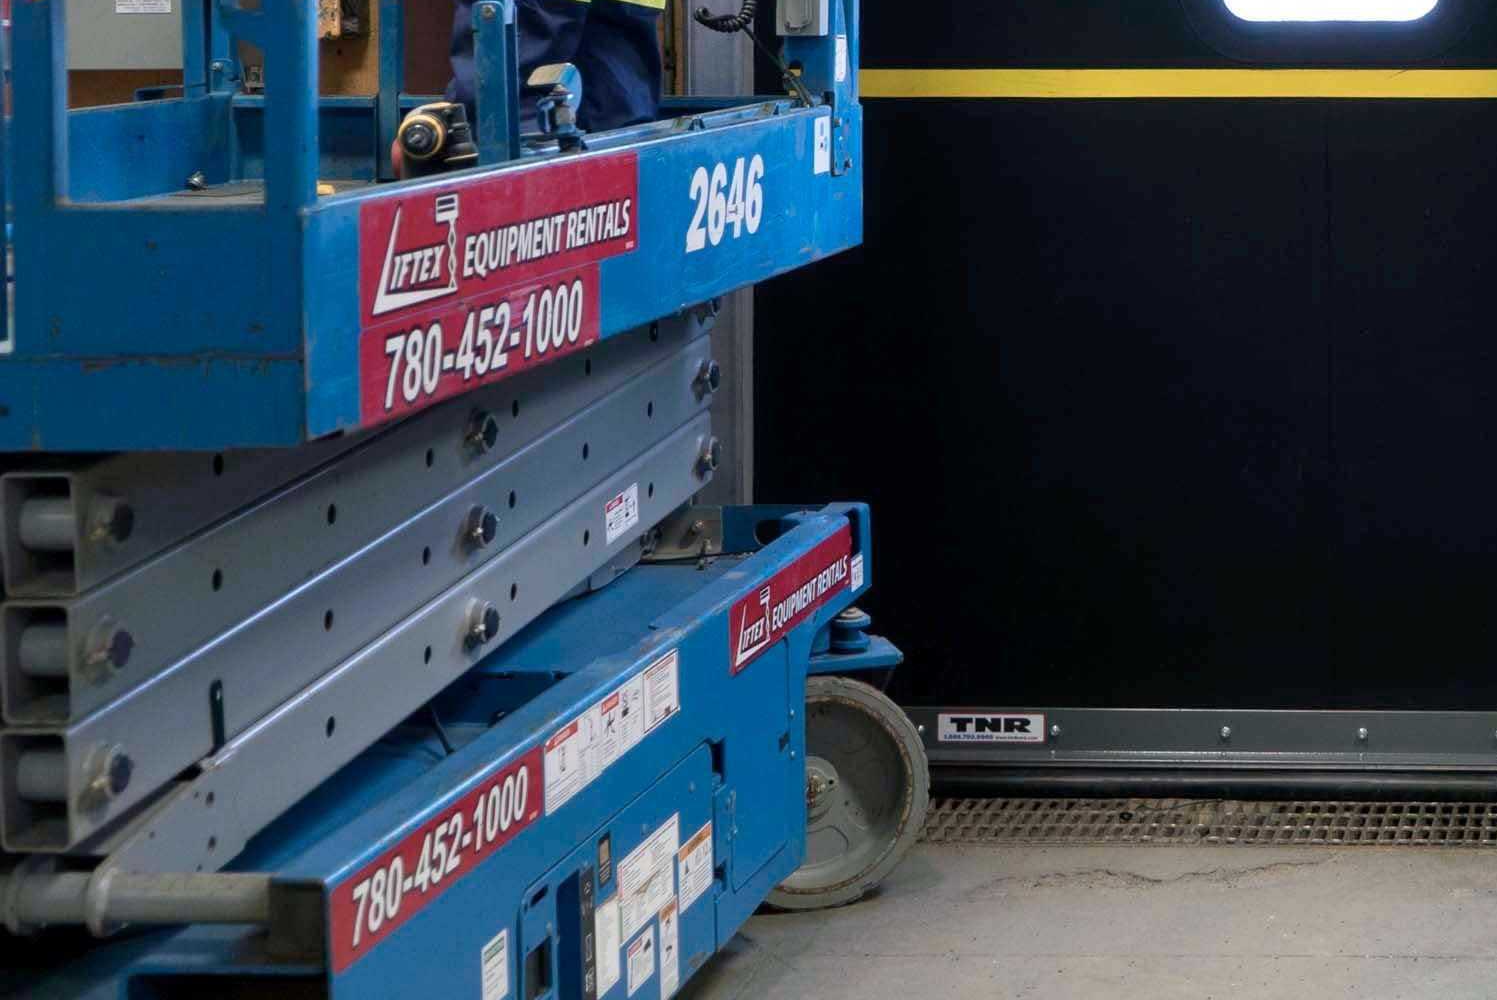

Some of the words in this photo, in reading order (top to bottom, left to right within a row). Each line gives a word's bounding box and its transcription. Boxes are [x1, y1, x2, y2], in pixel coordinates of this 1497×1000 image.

[372, 203, 458, 316] LIFTEX
[463, 215, 564, 278] EQUIPMENT
[566, 198, 631, 248] RENTALS
[686, 153, 764, 253] 2646
[384, 279, 584, 410] 780-452-1000
[772, 578, 818, 632] EQUIPMENT
[817, 555, 848, 597] RENTALS
[950, 717, 1032, 733] TNR
[352, 765, 529, 948] 780-452-1000
